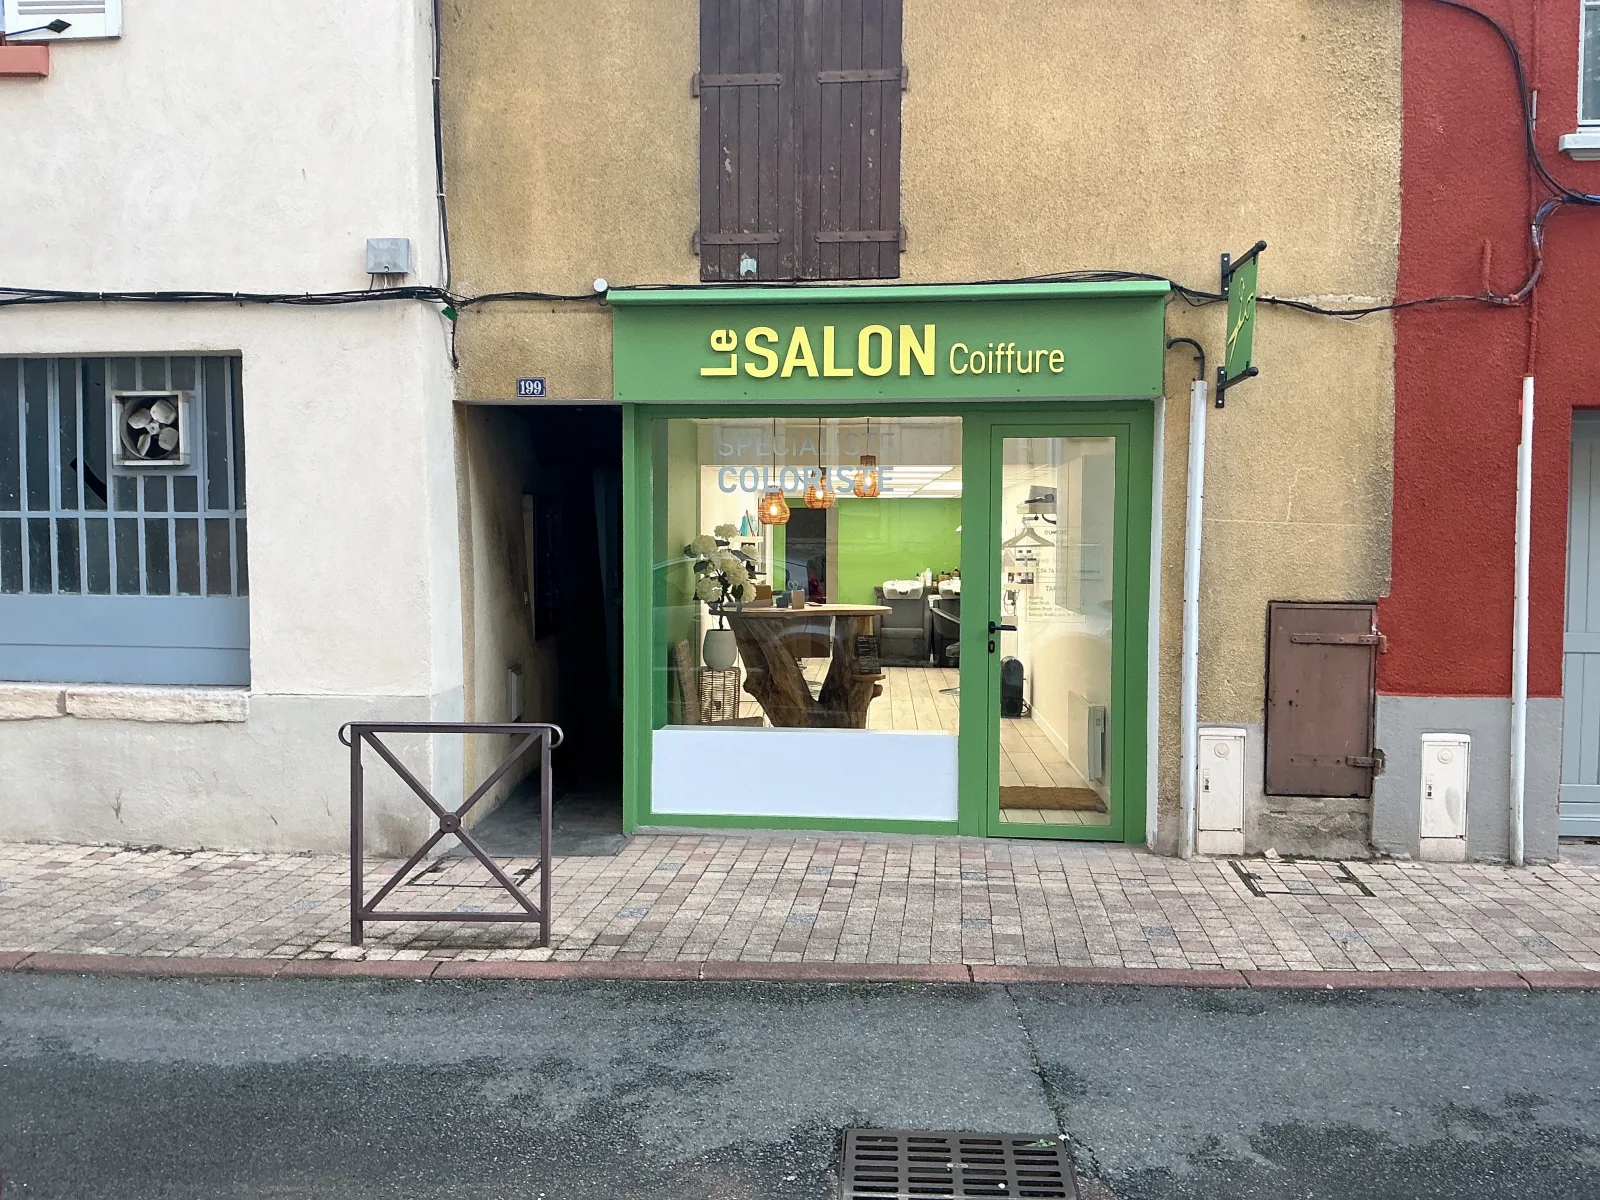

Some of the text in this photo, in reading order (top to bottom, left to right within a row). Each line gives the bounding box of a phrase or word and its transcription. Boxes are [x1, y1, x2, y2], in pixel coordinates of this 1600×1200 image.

[700, 324, 1065, 378] Le SALON Coiffure
[520, 380, 542, 395] 199
[717, 465, 894, 494] COLORISTE
